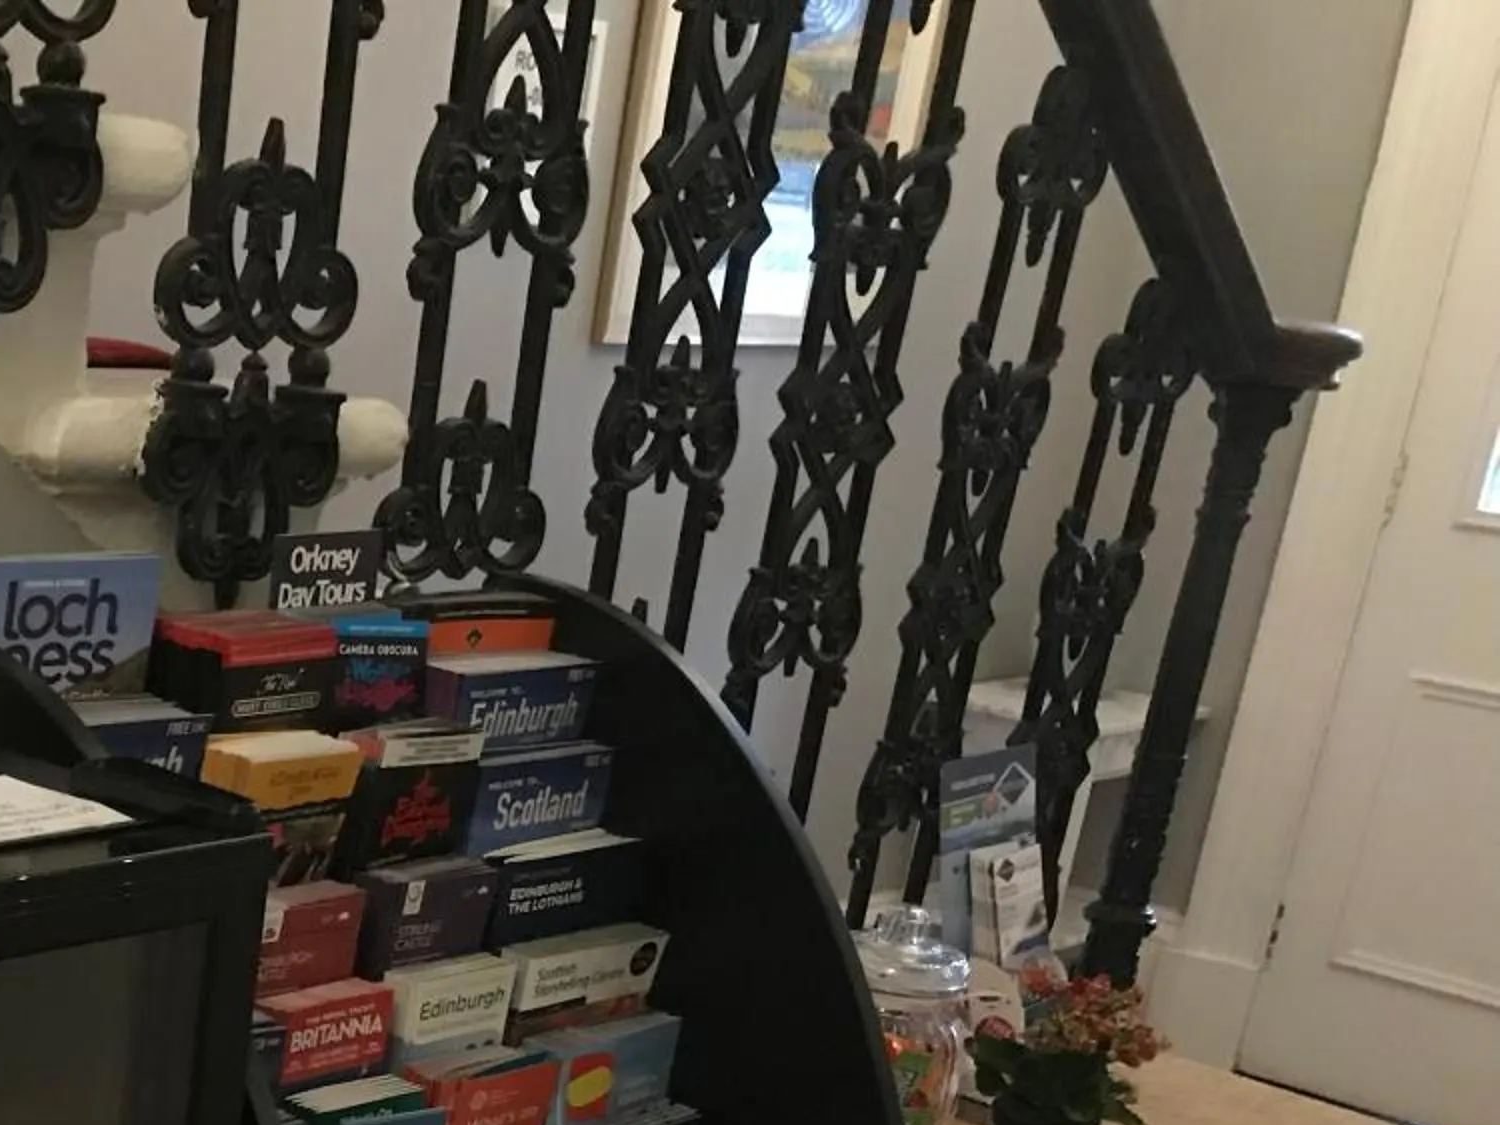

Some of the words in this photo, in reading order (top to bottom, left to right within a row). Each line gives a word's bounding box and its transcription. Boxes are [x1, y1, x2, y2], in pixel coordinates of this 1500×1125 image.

[290, 543, 361, 576] Orkney
[3, 577, 118, 640] loch
[277, 582, 315, 609] Day
[316, 579, 367, 605] Tours
[470, 693, 579, 738] Edinburgh
[493, 778, 590, 831] Scotland
[508, 900, 529, 916] THE
[419, 985, 506, 1021] Edinburgh
[291, 1013, 383, 1053] BRITANNIA
